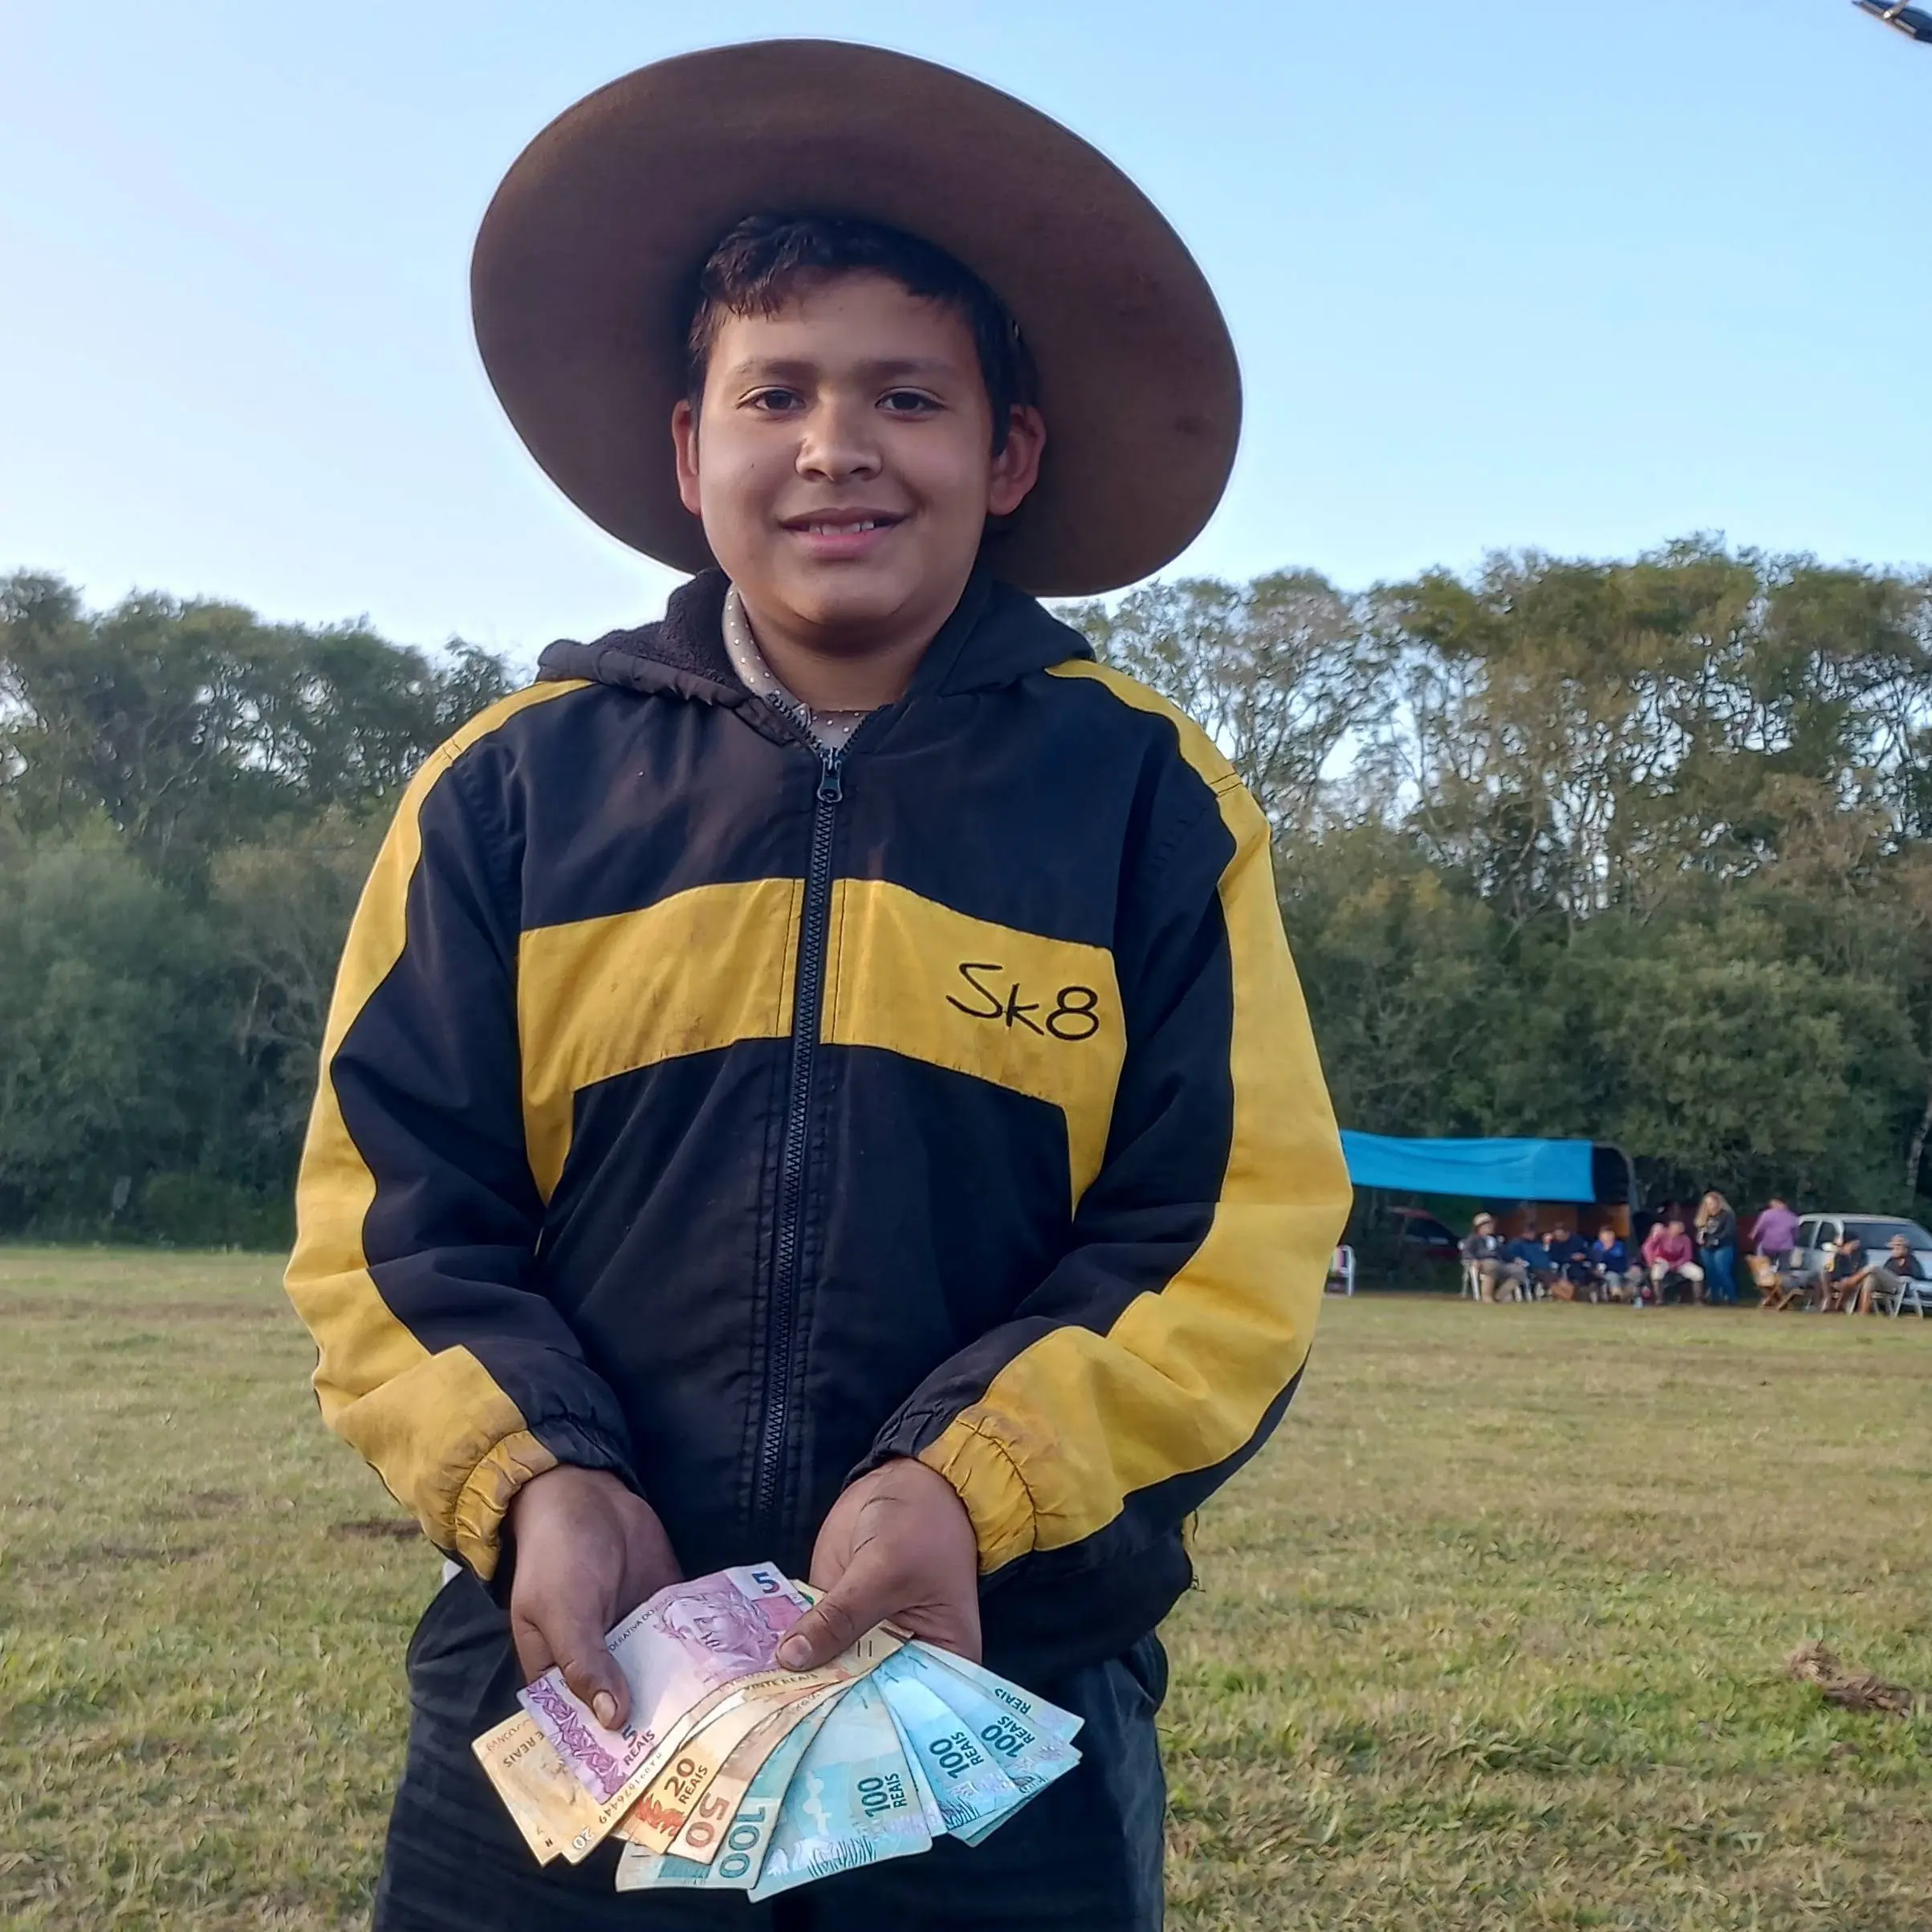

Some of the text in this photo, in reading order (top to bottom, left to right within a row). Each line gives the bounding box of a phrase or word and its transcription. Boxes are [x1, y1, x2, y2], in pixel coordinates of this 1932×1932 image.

[946, 962, 1100, 1041] Sk8
[751, 1572, 779, 1593] 5
[622, 1725, 637, 1748] 5
[981, 1724, 1025, 1758] 100
[998, 1715, 1035, 1744] REAIS
[503, 1737, 536, 1767] REAIS
[623, 1730, 655, 1766] REAIS
[929, 1739, 970, 1779] 100
[950, 1731, 984, 1766] REAIS
[664, 1758, 695, 1797] 20
[678, 1764, 708, 1804] REAIS
[885, 1773, 908, 1808] REAIS
[856, 1776, 890, 1818] 100
[685, 1792, 730, 1847] 50
[719, 1806, 765, 1878] 100
